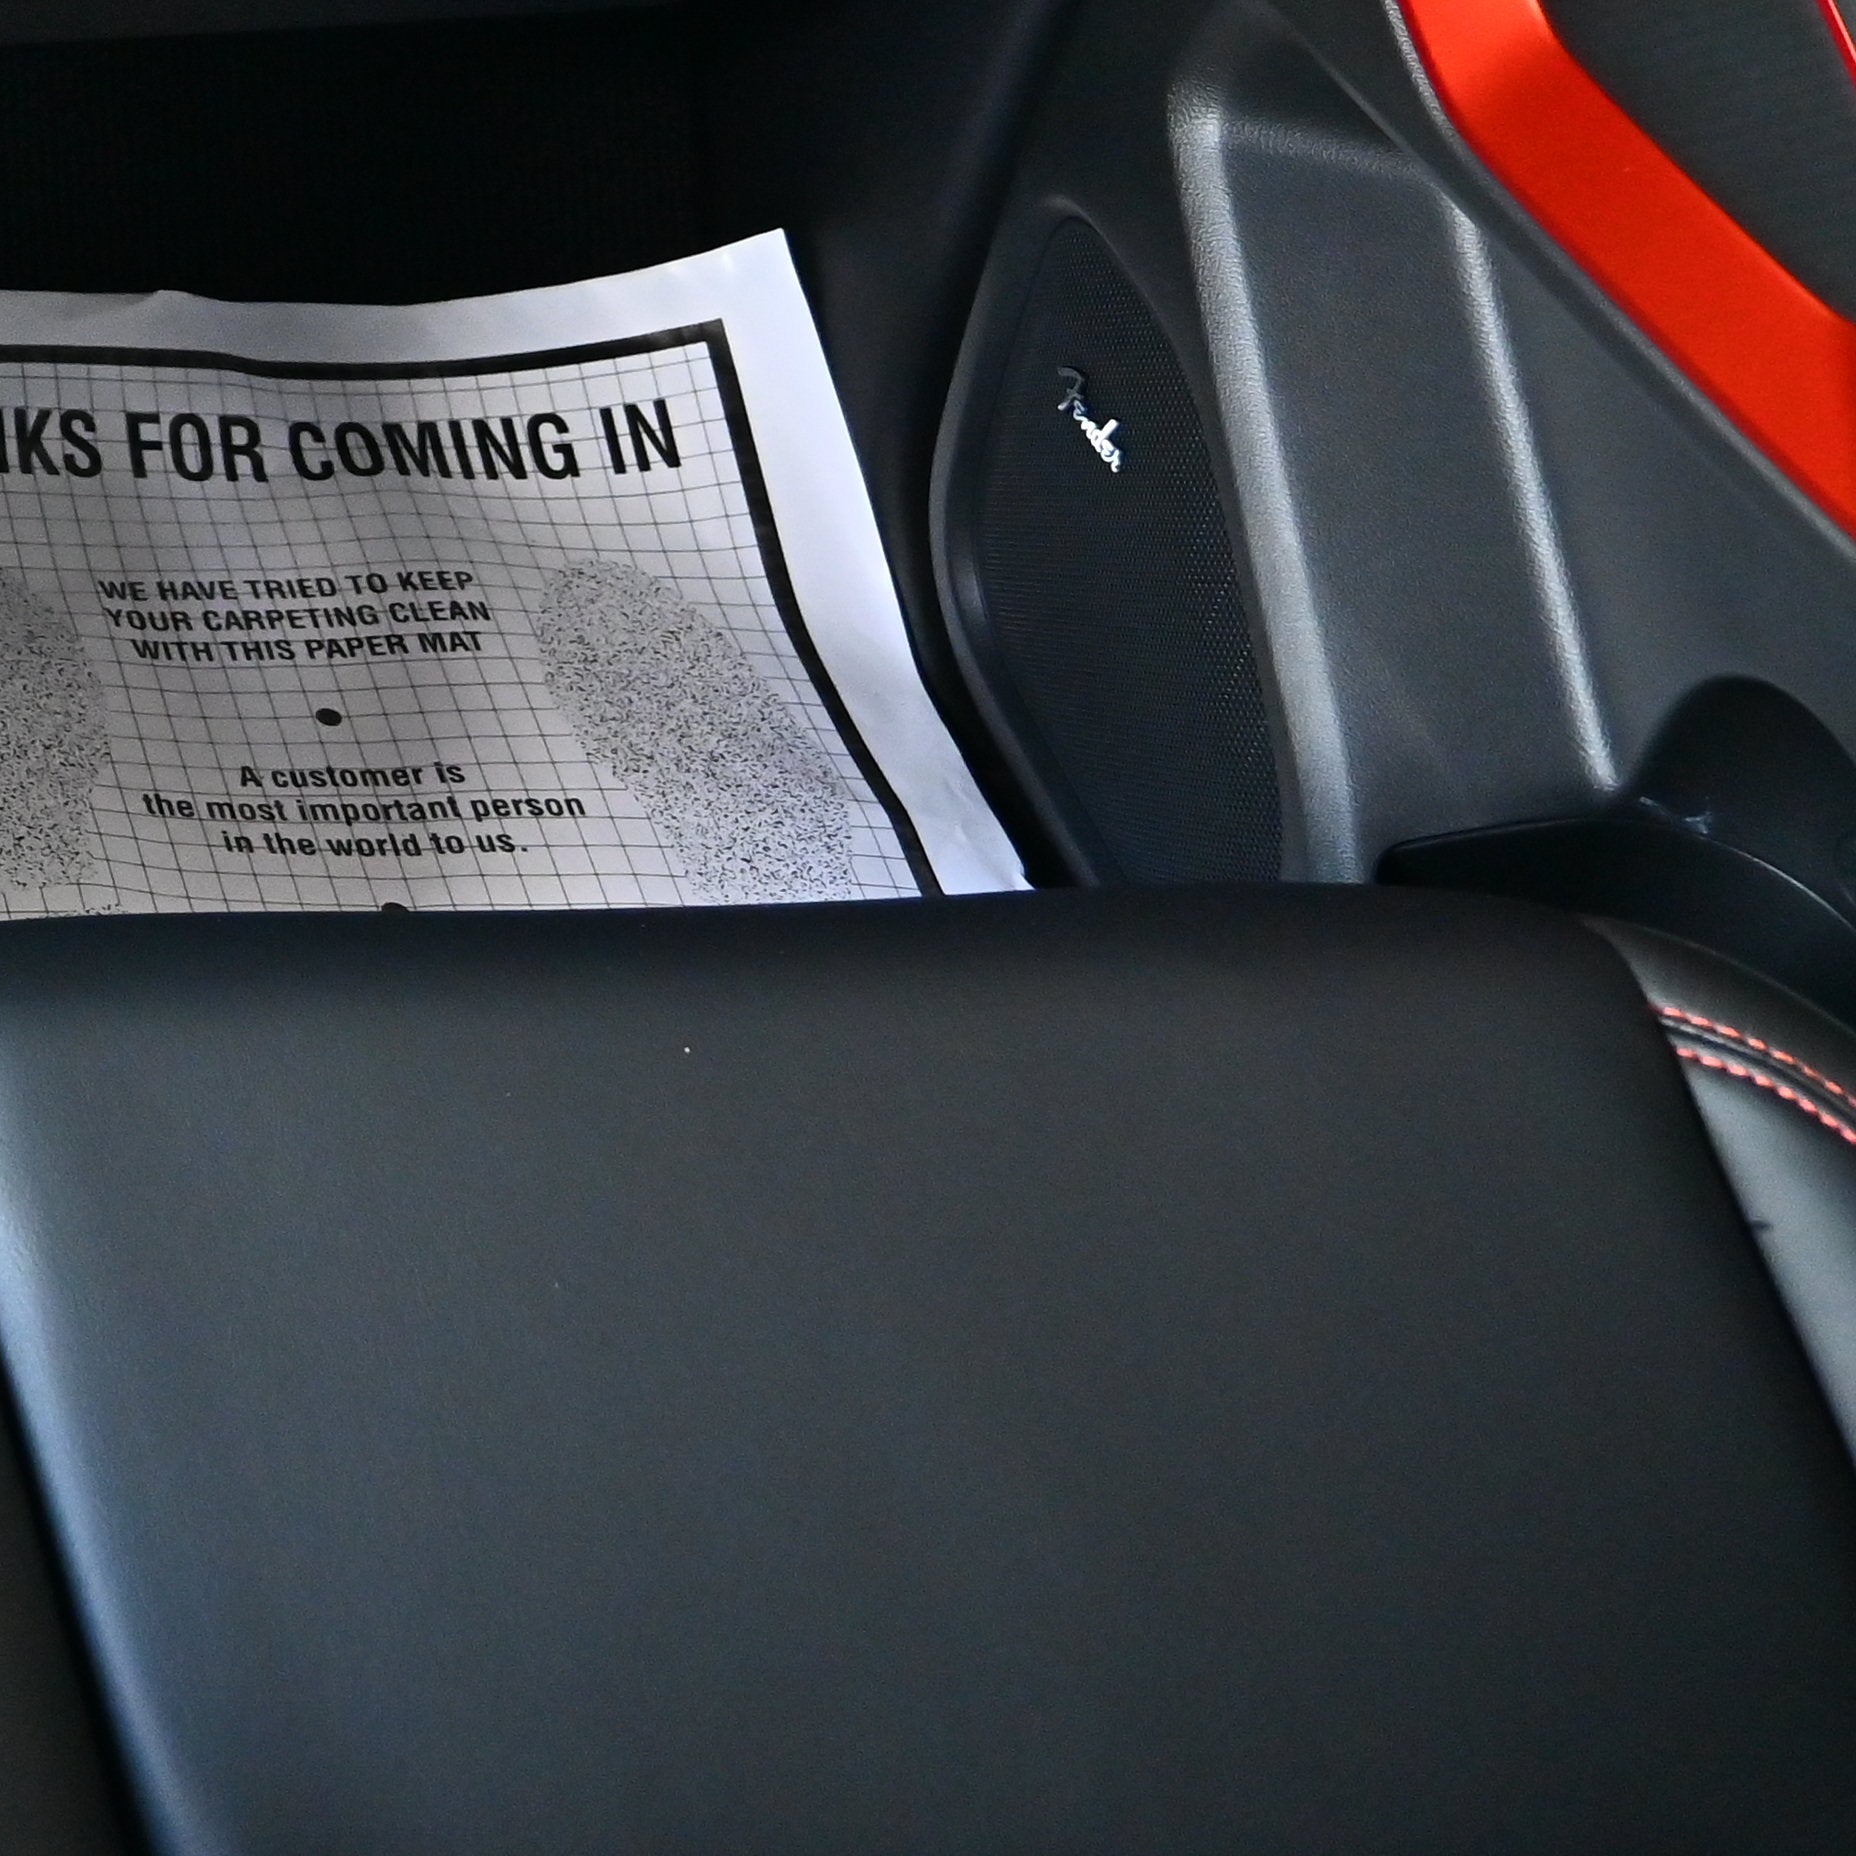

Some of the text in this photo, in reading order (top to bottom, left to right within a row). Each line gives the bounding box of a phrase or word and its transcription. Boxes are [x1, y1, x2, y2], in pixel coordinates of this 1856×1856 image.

[125, 411, 269, 483] FOR
[288, 412, 581, 482] COMING
[599, 398, 682, 475] IN
[98, 571, 474, 603] WE HAVE TRIED TO KEEP
[105, 601, 492, 632] YOUR CARPETING CLEAN
[130, 630, 485, 663] WITH THIS PAPER MAT
[270, 761, 467, 788] customer is
[142, 793, 587, 826] the most important person
[222, 830, 529, 857] in the world to us.
